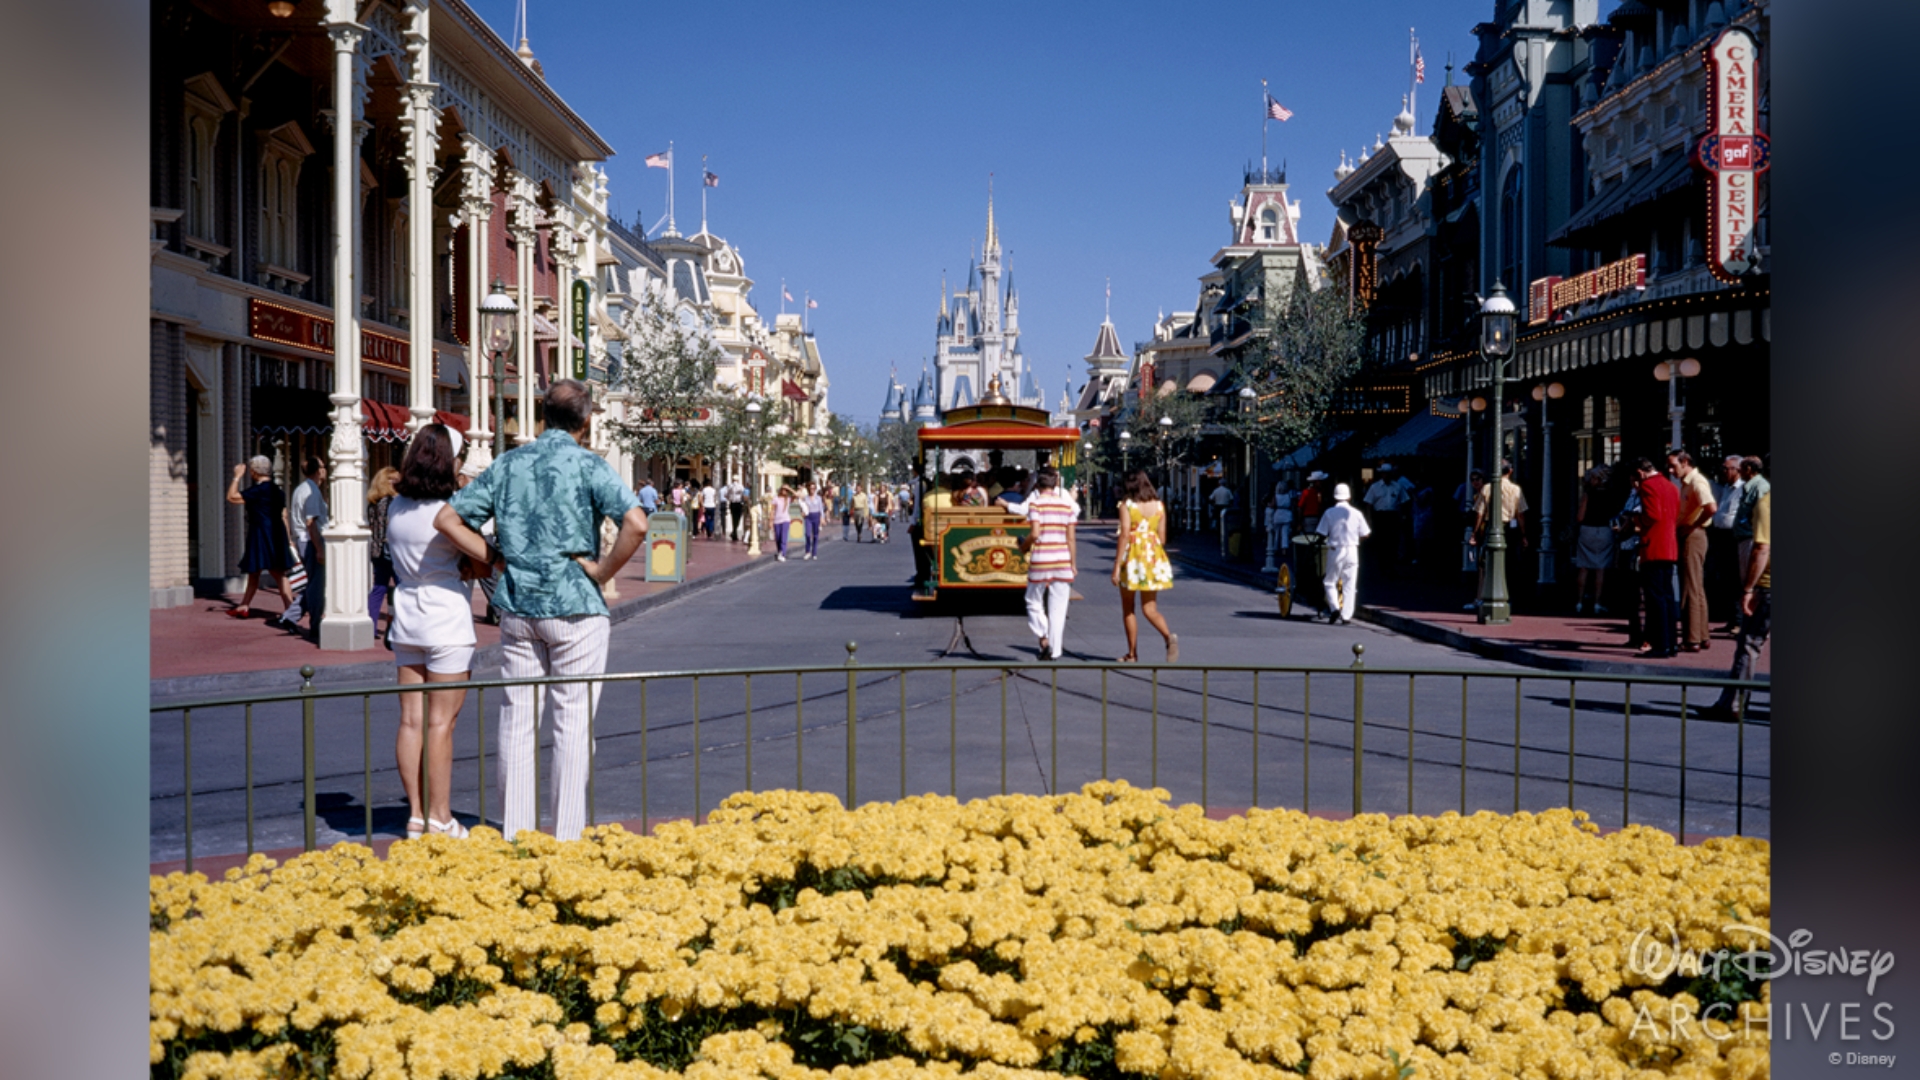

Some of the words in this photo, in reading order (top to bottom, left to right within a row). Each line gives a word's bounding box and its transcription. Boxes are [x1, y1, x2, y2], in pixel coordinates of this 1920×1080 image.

[1727, 46, 1747, 134] CAMERA
[1724, 144, 1749, 162] gaf
[1728, 173, 1747, 263] CENTER
[1597, 255, 1638, 296] CENTER
[312, 320, 403, 364] ERIUM
[575, 287, 584, 373] ARCADE
[992, 551, 1005, 565] 2
